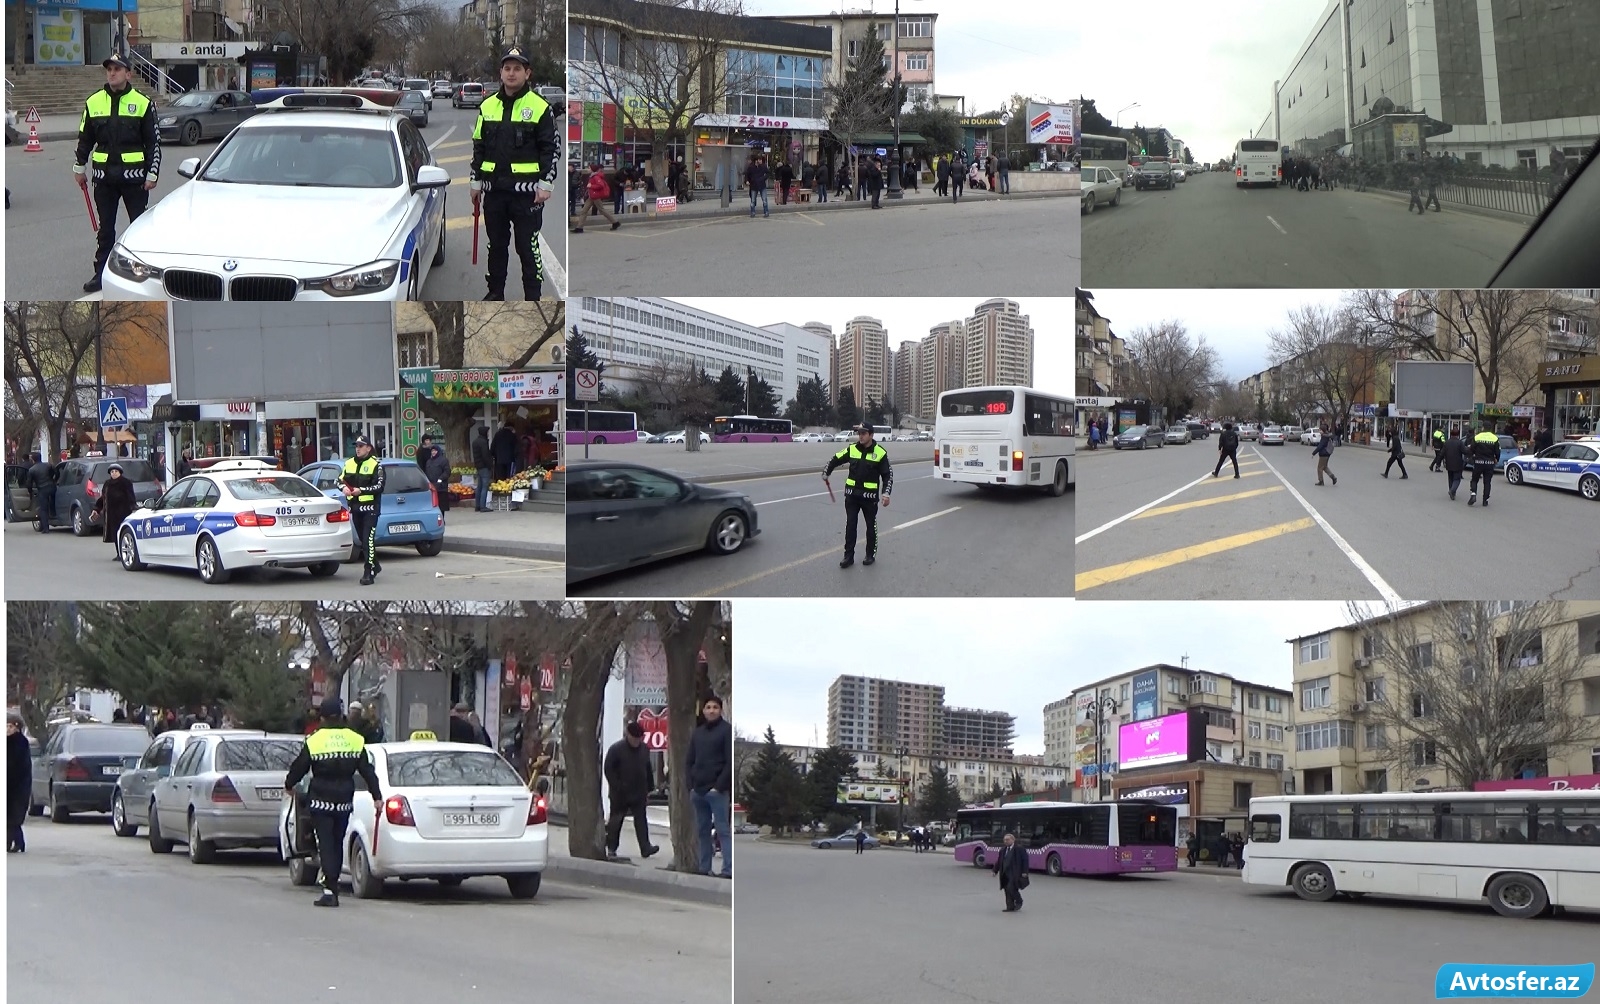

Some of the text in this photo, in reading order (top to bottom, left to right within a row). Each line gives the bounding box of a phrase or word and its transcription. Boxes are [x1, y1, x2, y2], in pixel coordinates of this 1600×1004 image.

[180, 43, 226, 57] avantaj
[758, 117, 789, 129] Shop
[1545, 364, 1581, 377] BANU
[986, 402, 1006, 413] 199
[402, 389, 419, 458] FOTO
[275, 506, 292, 515] 405
[643, 731, 668, 748] 70
[1120, 788, 1188, 800] LOMBARD
